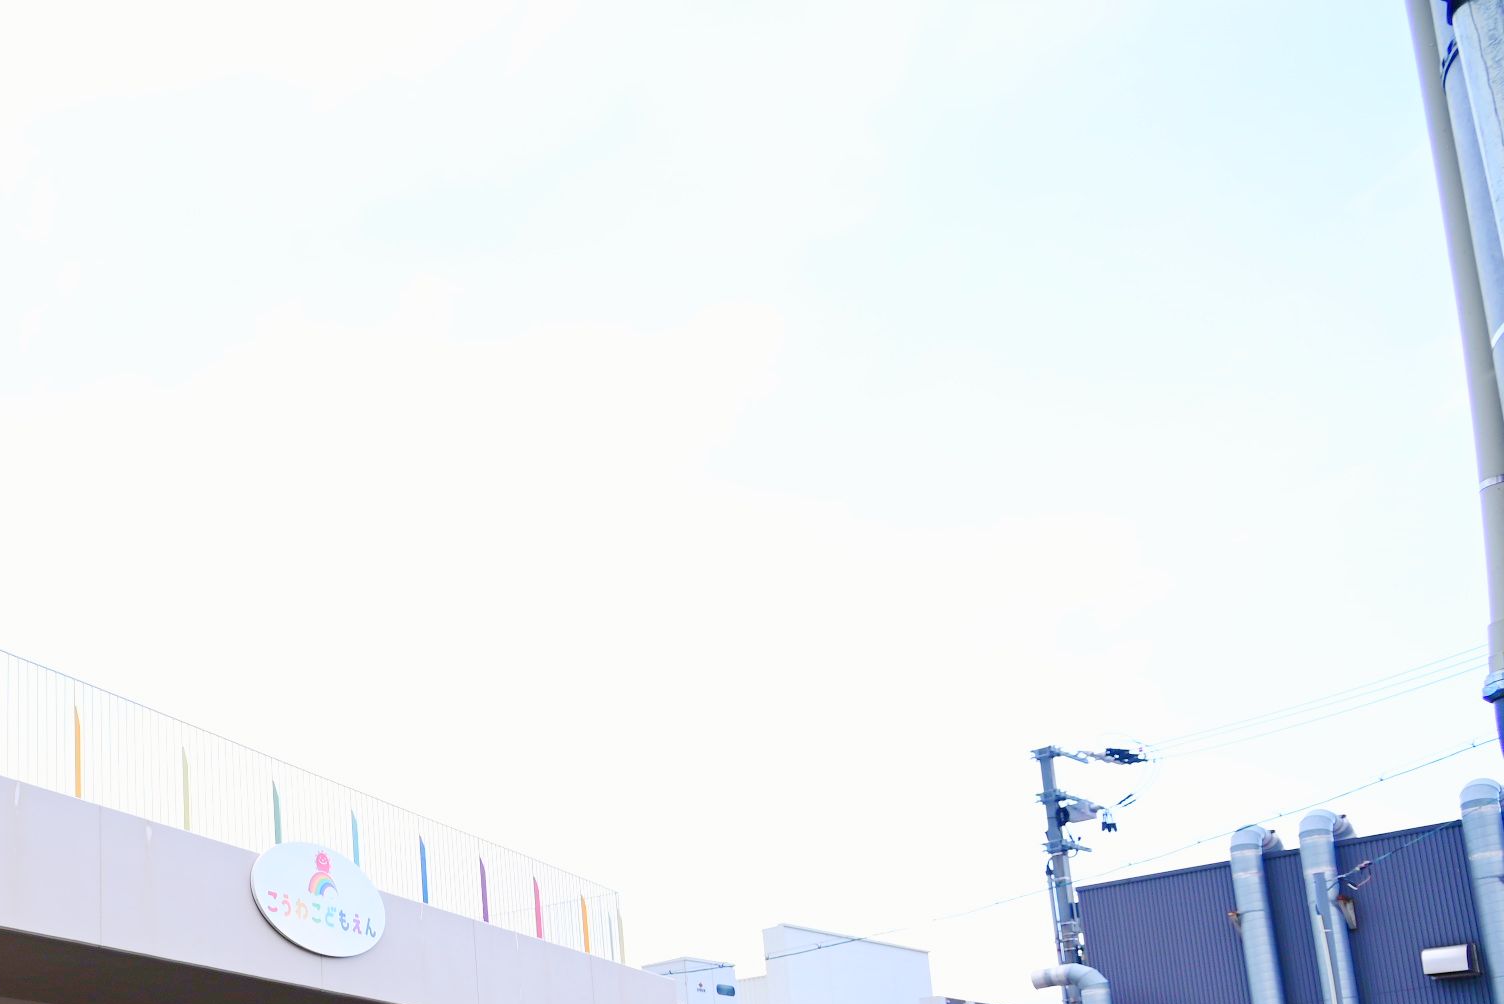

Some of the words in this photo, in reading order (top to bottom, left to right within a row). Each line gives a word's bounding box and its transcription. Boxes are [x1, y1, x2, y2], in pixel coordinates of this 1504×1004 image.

[267, 890, 377, 938] こうわこどもえん
